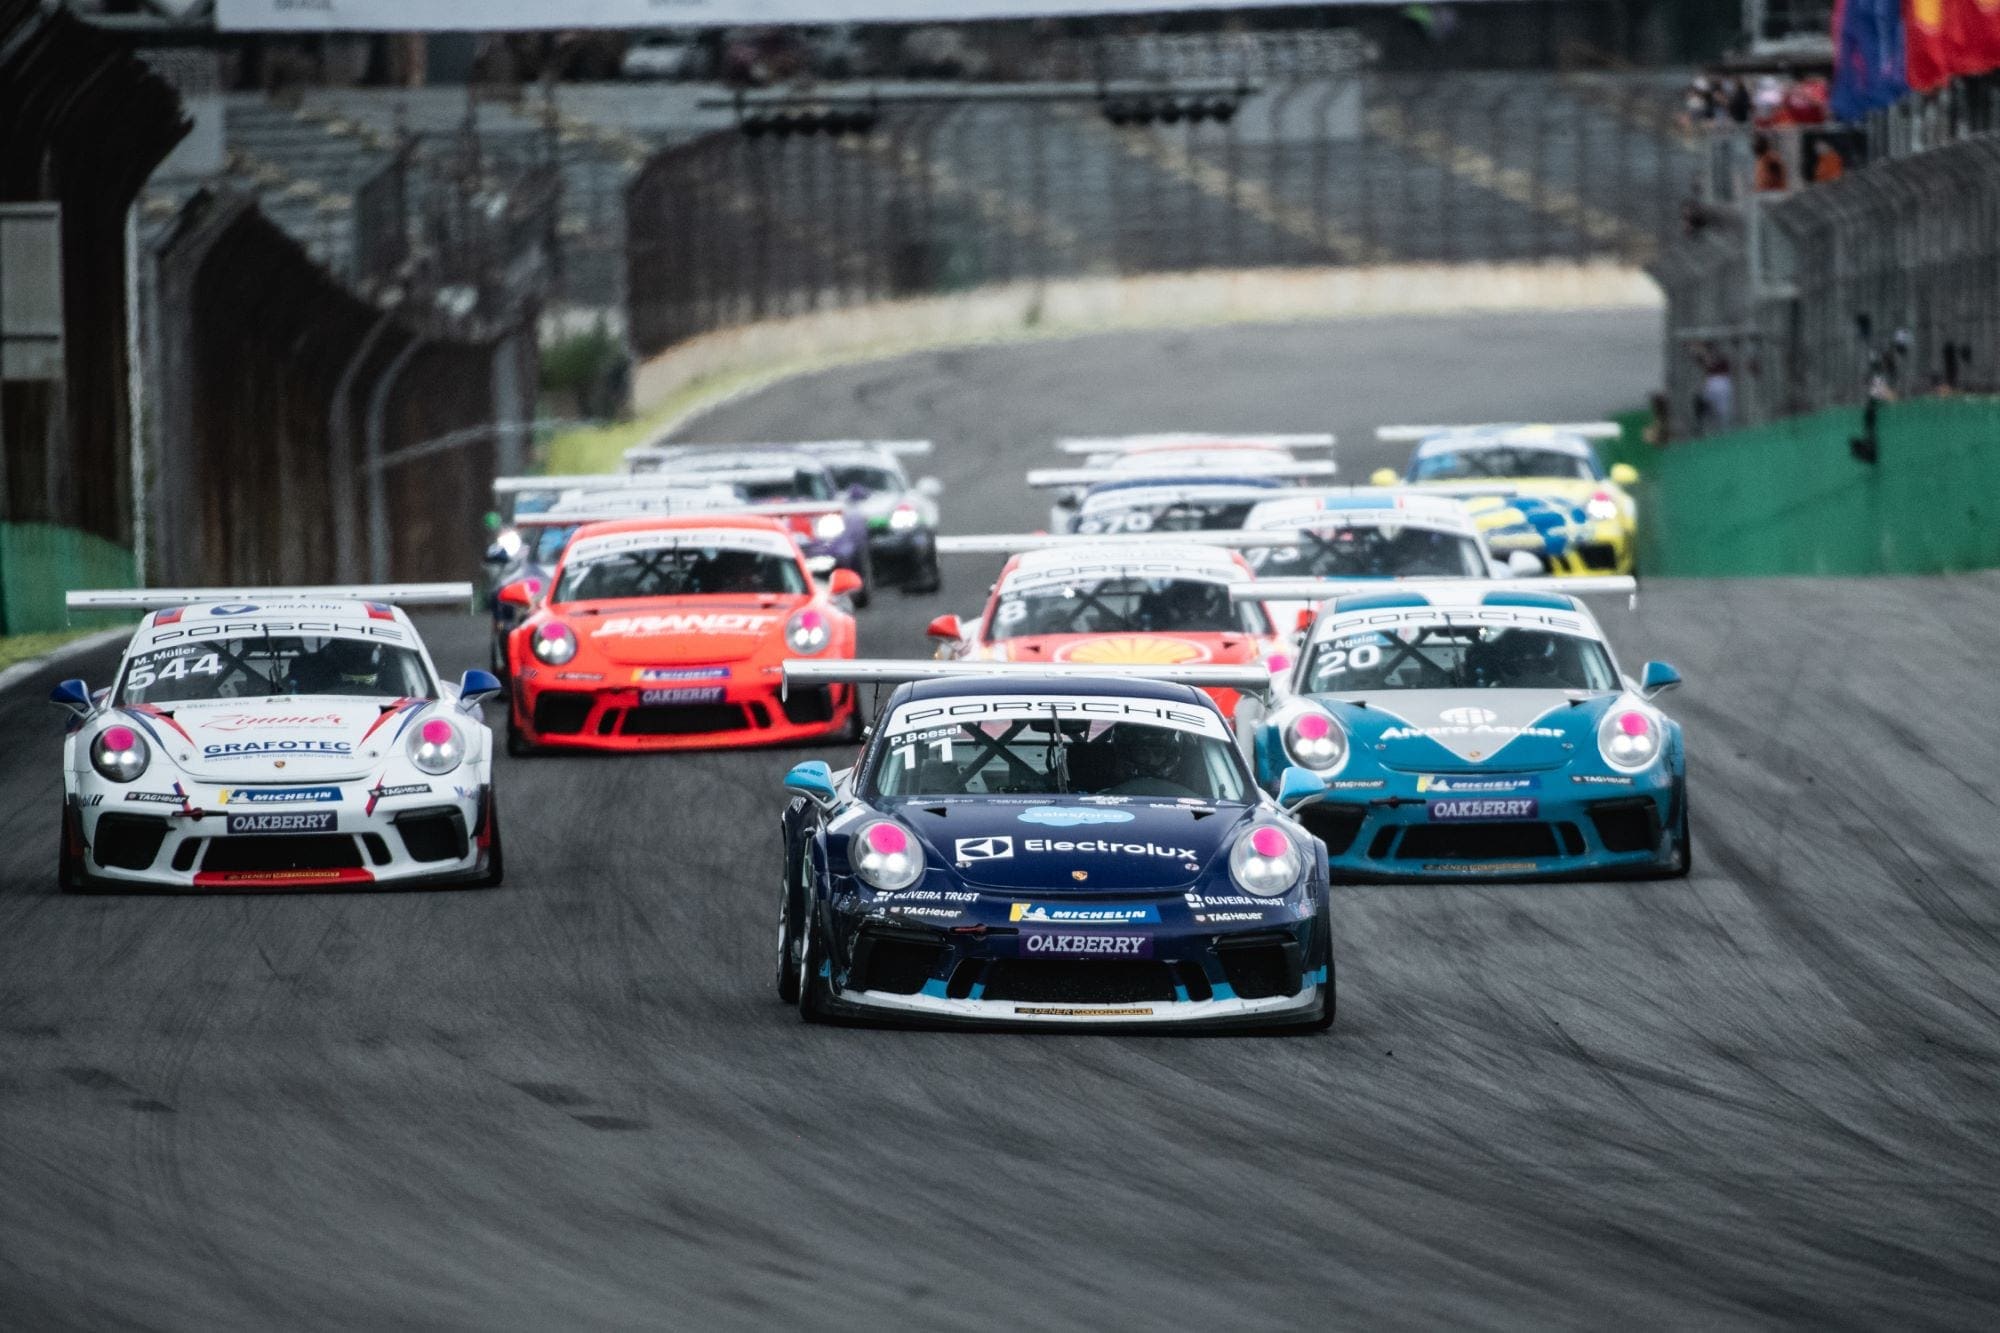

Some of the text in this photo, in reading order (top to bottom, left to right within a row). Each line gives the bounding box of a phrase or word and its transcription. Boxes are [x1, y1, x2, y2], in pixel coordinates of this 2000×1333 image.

[1014, 564, 1235, 583] PORSCHE
[1000, 600, 1028, 624] 8
[1332, 611, 1581, 631] PORSCHE
[152, 622, 403, 645] PORSCHE
[592, 613, 780, 637] BRANDT
[1335, 633, 1379, 649] Aguiar
[134, 646, 198, 668] M. Müller
[1317, 645, 1381, 678] 20
[127, 653, 223, 691] 544
[642, 687, 720, 703] OAKBERRY
[905, 701, 1207, 728] PORSCHE
[890, 724, 963, 747] P.Boesel
[203, 740, 352, 755] GRAFOTEC
[892, 737, 953, 770] 11
[1450, 779, 1532, 790] MICHELIN
[253, 790, 333, 801] MICHELIN
[1433, 799, 1533, 818] OAKBERRY
[232, 813, 332, 831] OAKBERRY
[1024, 838, 1199, 861] Electrolux
[894, 890, 980, 902] OLIVEIRA TRUST
[1204, 895, 1286, 907] OLIVEIRA TRUST
[1051, 910, 1147, 919] MICHELIN
[1026, 934, 1146, 954] OAKBERRY
[1034, 1008, 1152, 1016] DENER MOTORSPORT
